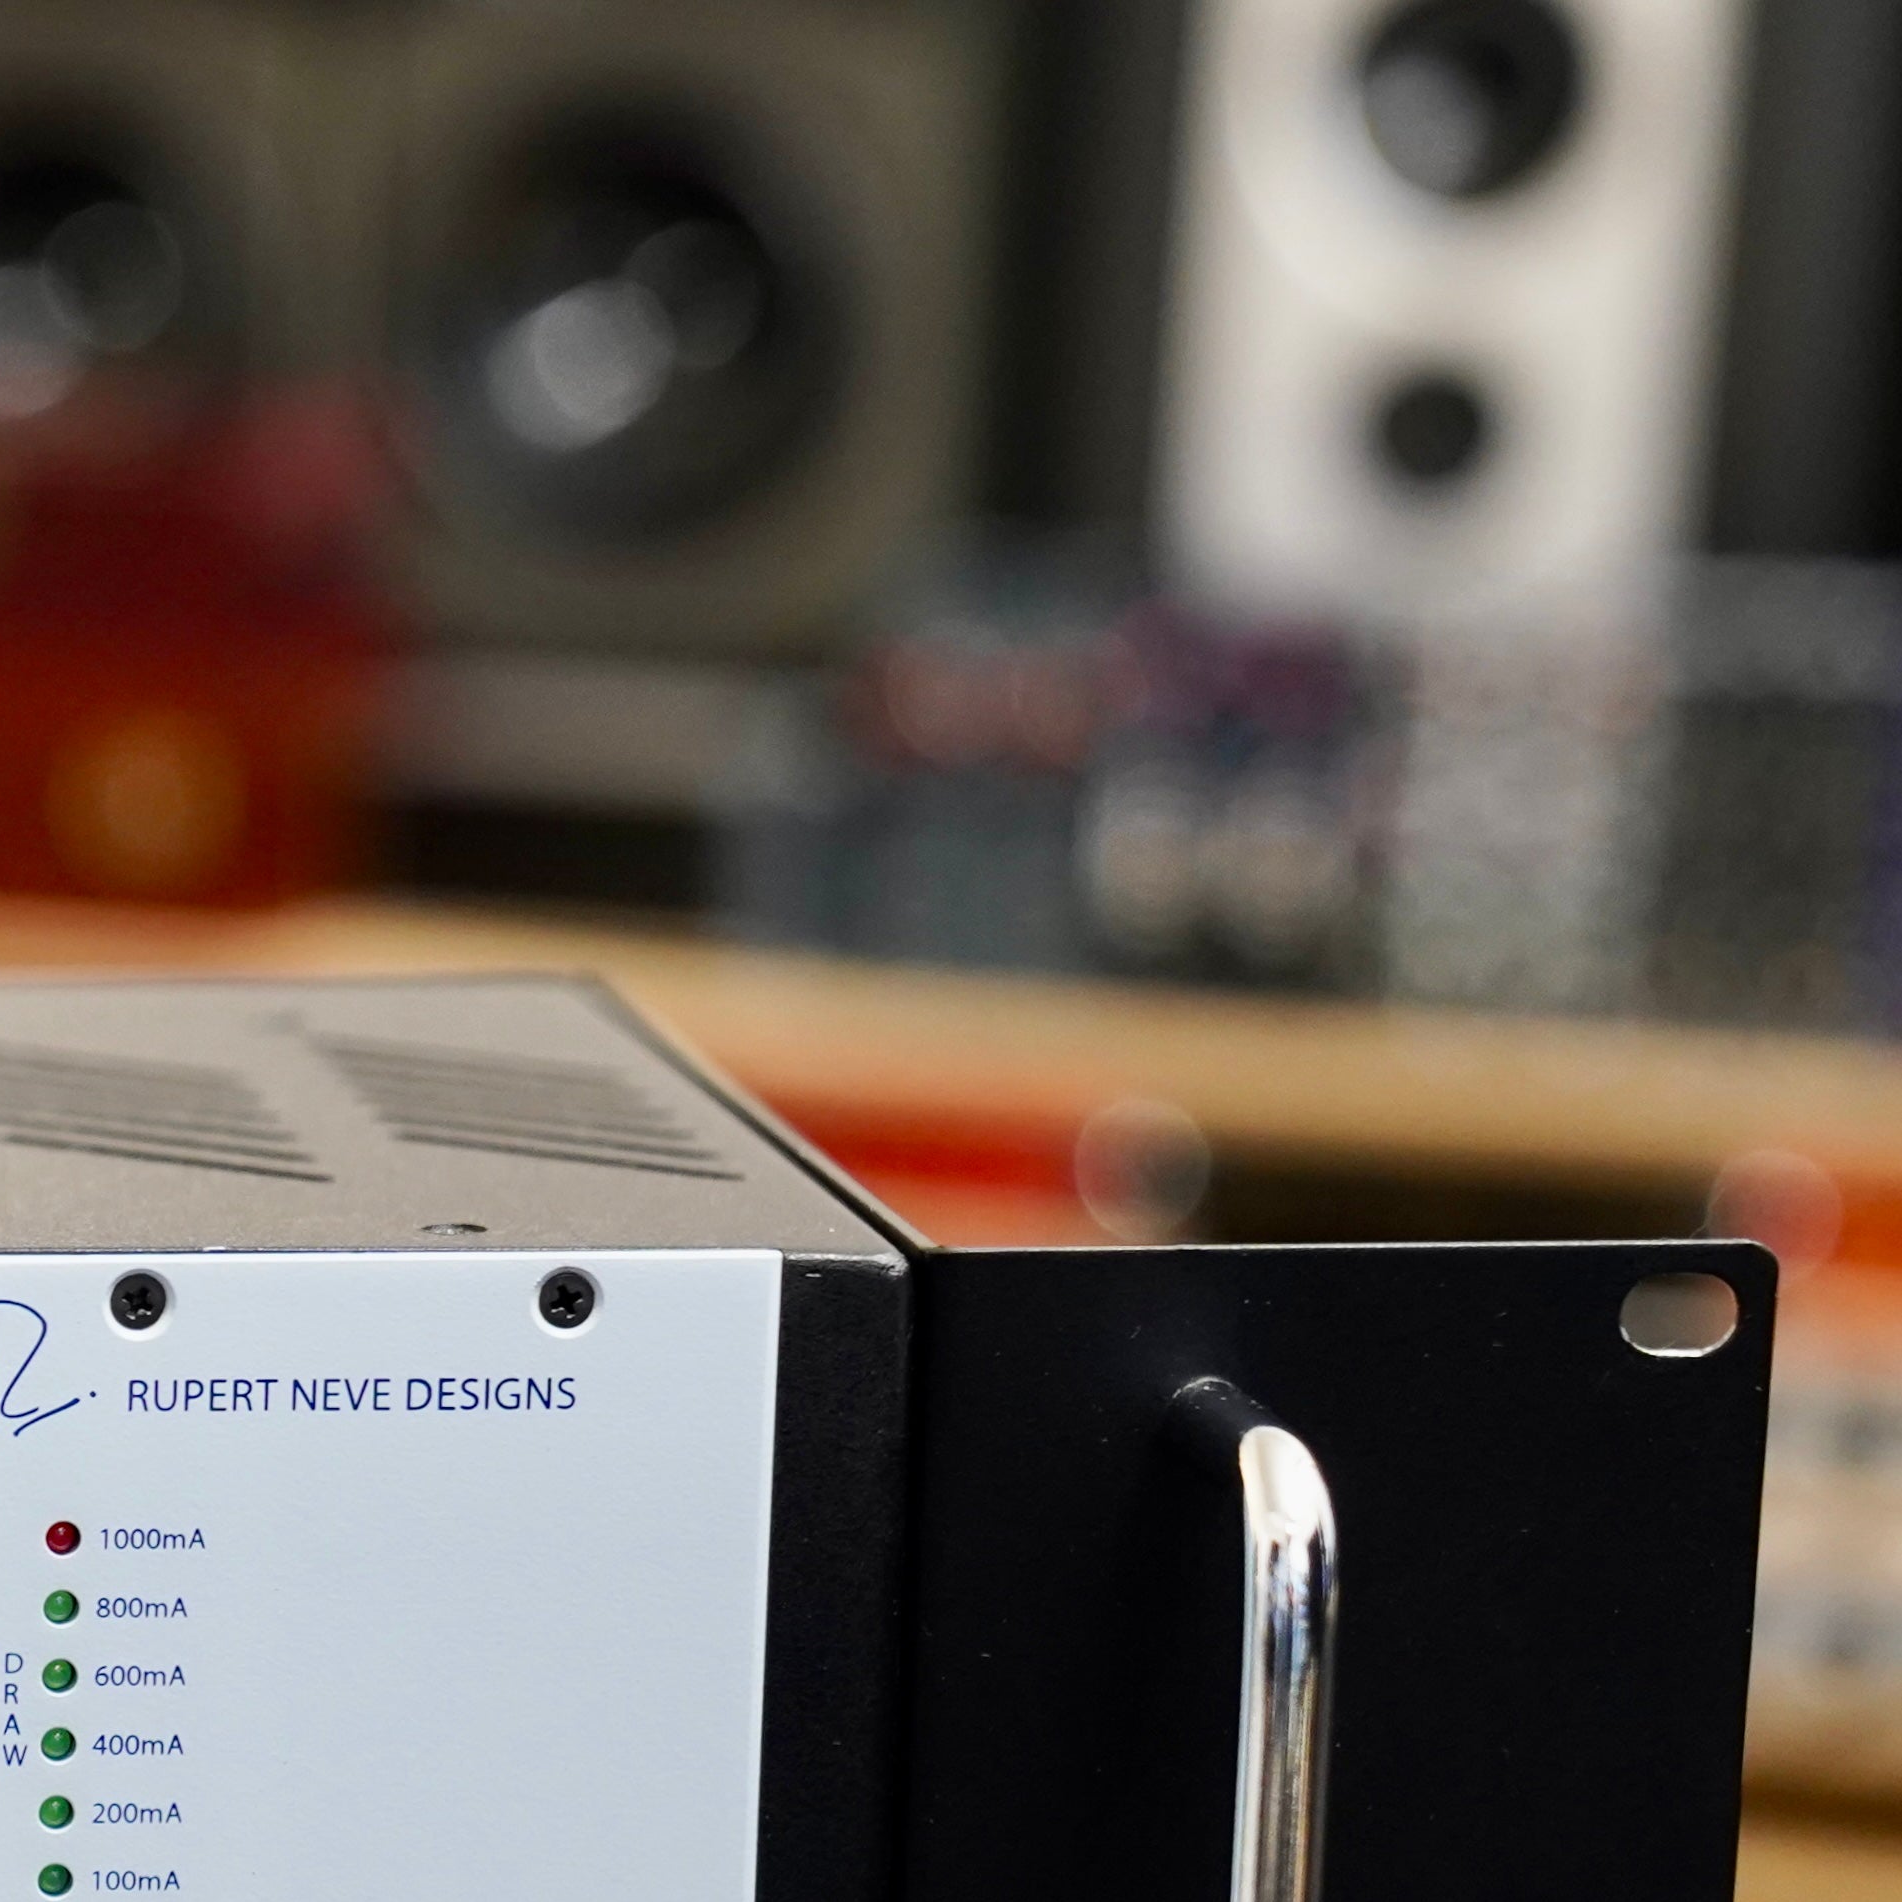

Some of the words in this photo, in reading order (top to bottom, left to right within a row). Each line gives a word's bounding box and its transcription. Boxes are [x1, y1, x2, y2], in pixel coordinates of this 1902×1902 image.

[127, 1378, 280, 1413] RUPERT
[291, 1377, 392, 1412] NEVE
[405, 1376, 577, 1412] DESIGNS
[99, 1527, 206, 1550] 1000mA
[95, 1596, 188, 1619] 800mA
[94, 1664, 186, 1687] 600mA
[2, 1652, 28, 1767] DRAW
[91, 1733, 184, 1756] 400mA
[91, 1802, 182, 1825] 200mA
[91, 1870, 181, 1892] 100mA
